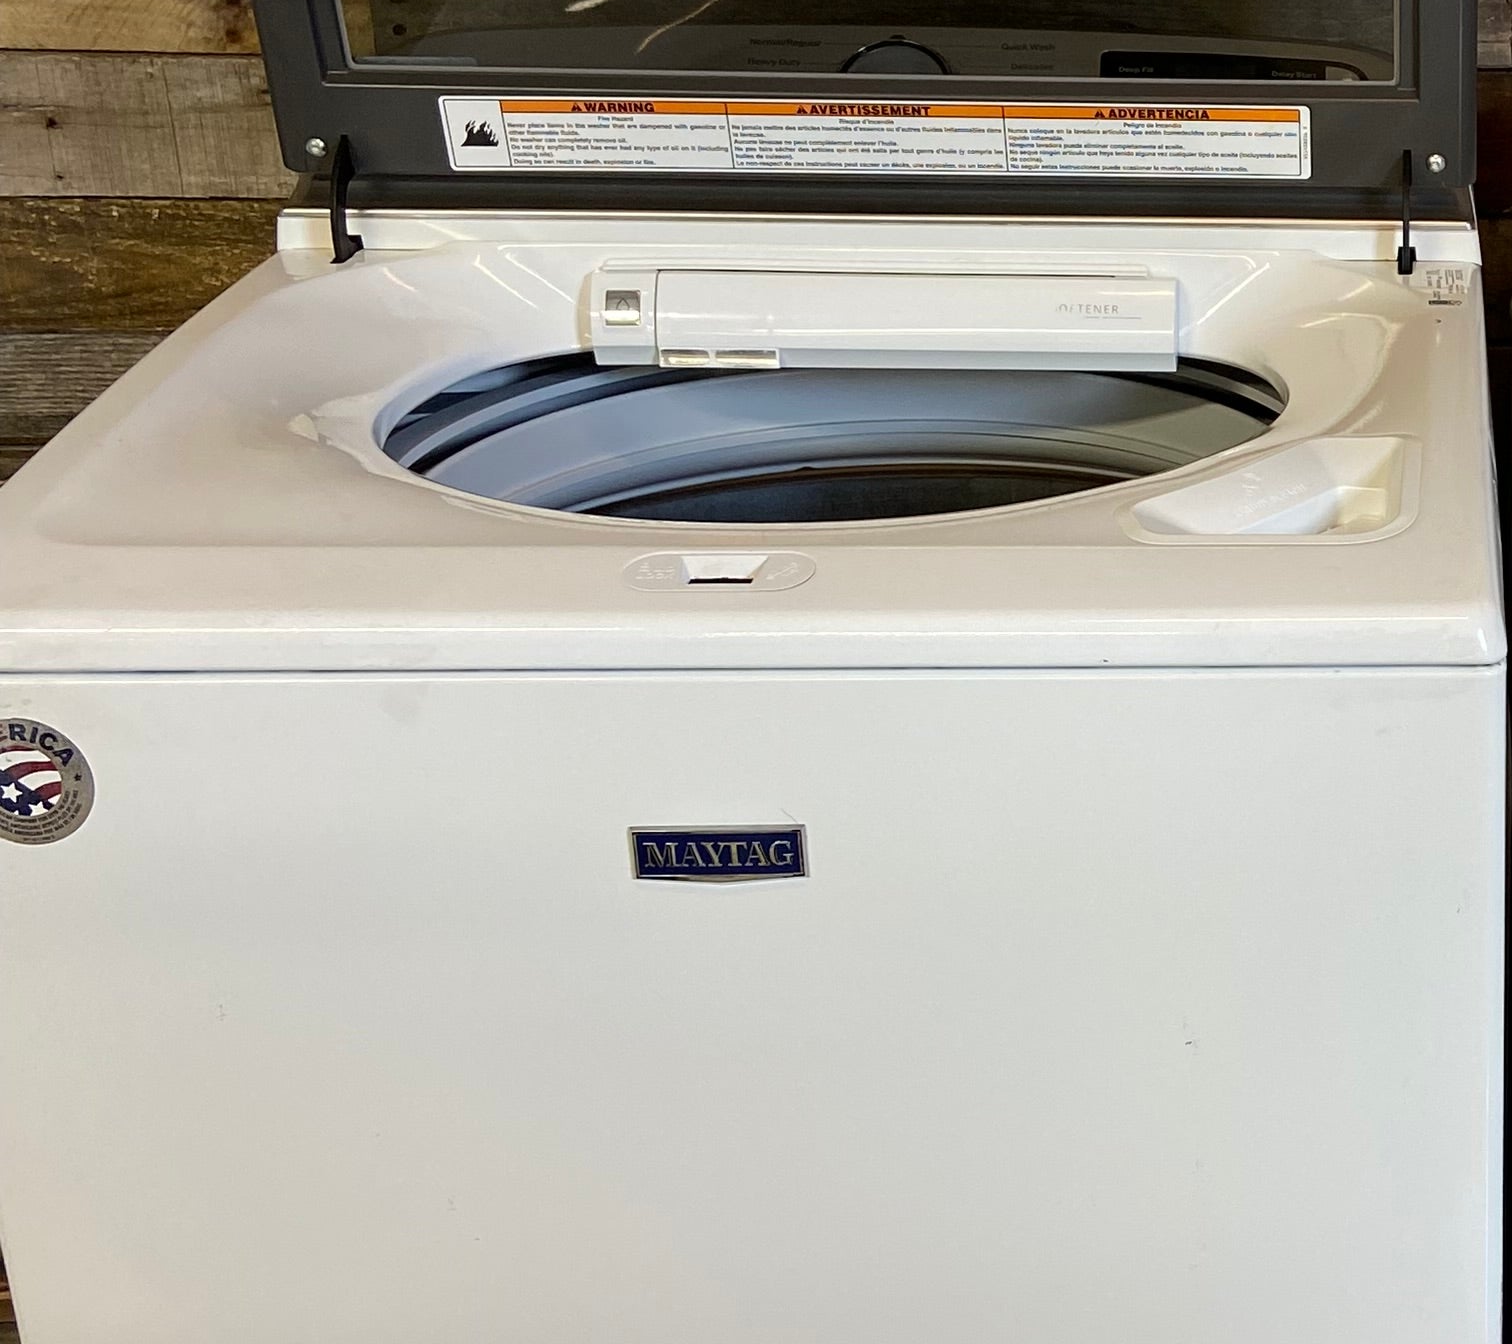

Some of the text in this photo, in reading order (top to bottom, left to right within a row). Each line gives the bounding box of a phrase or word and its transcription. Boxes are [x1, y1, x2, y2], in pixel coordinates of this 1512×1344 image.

[584, 102, 655, 113] WARNING
[810, 105, 931, 117] AVERTISSEMENT
[1108, 108, 1210, 120] ADVERTENCIA
[642, 840, 795, 868] MAYTAG
